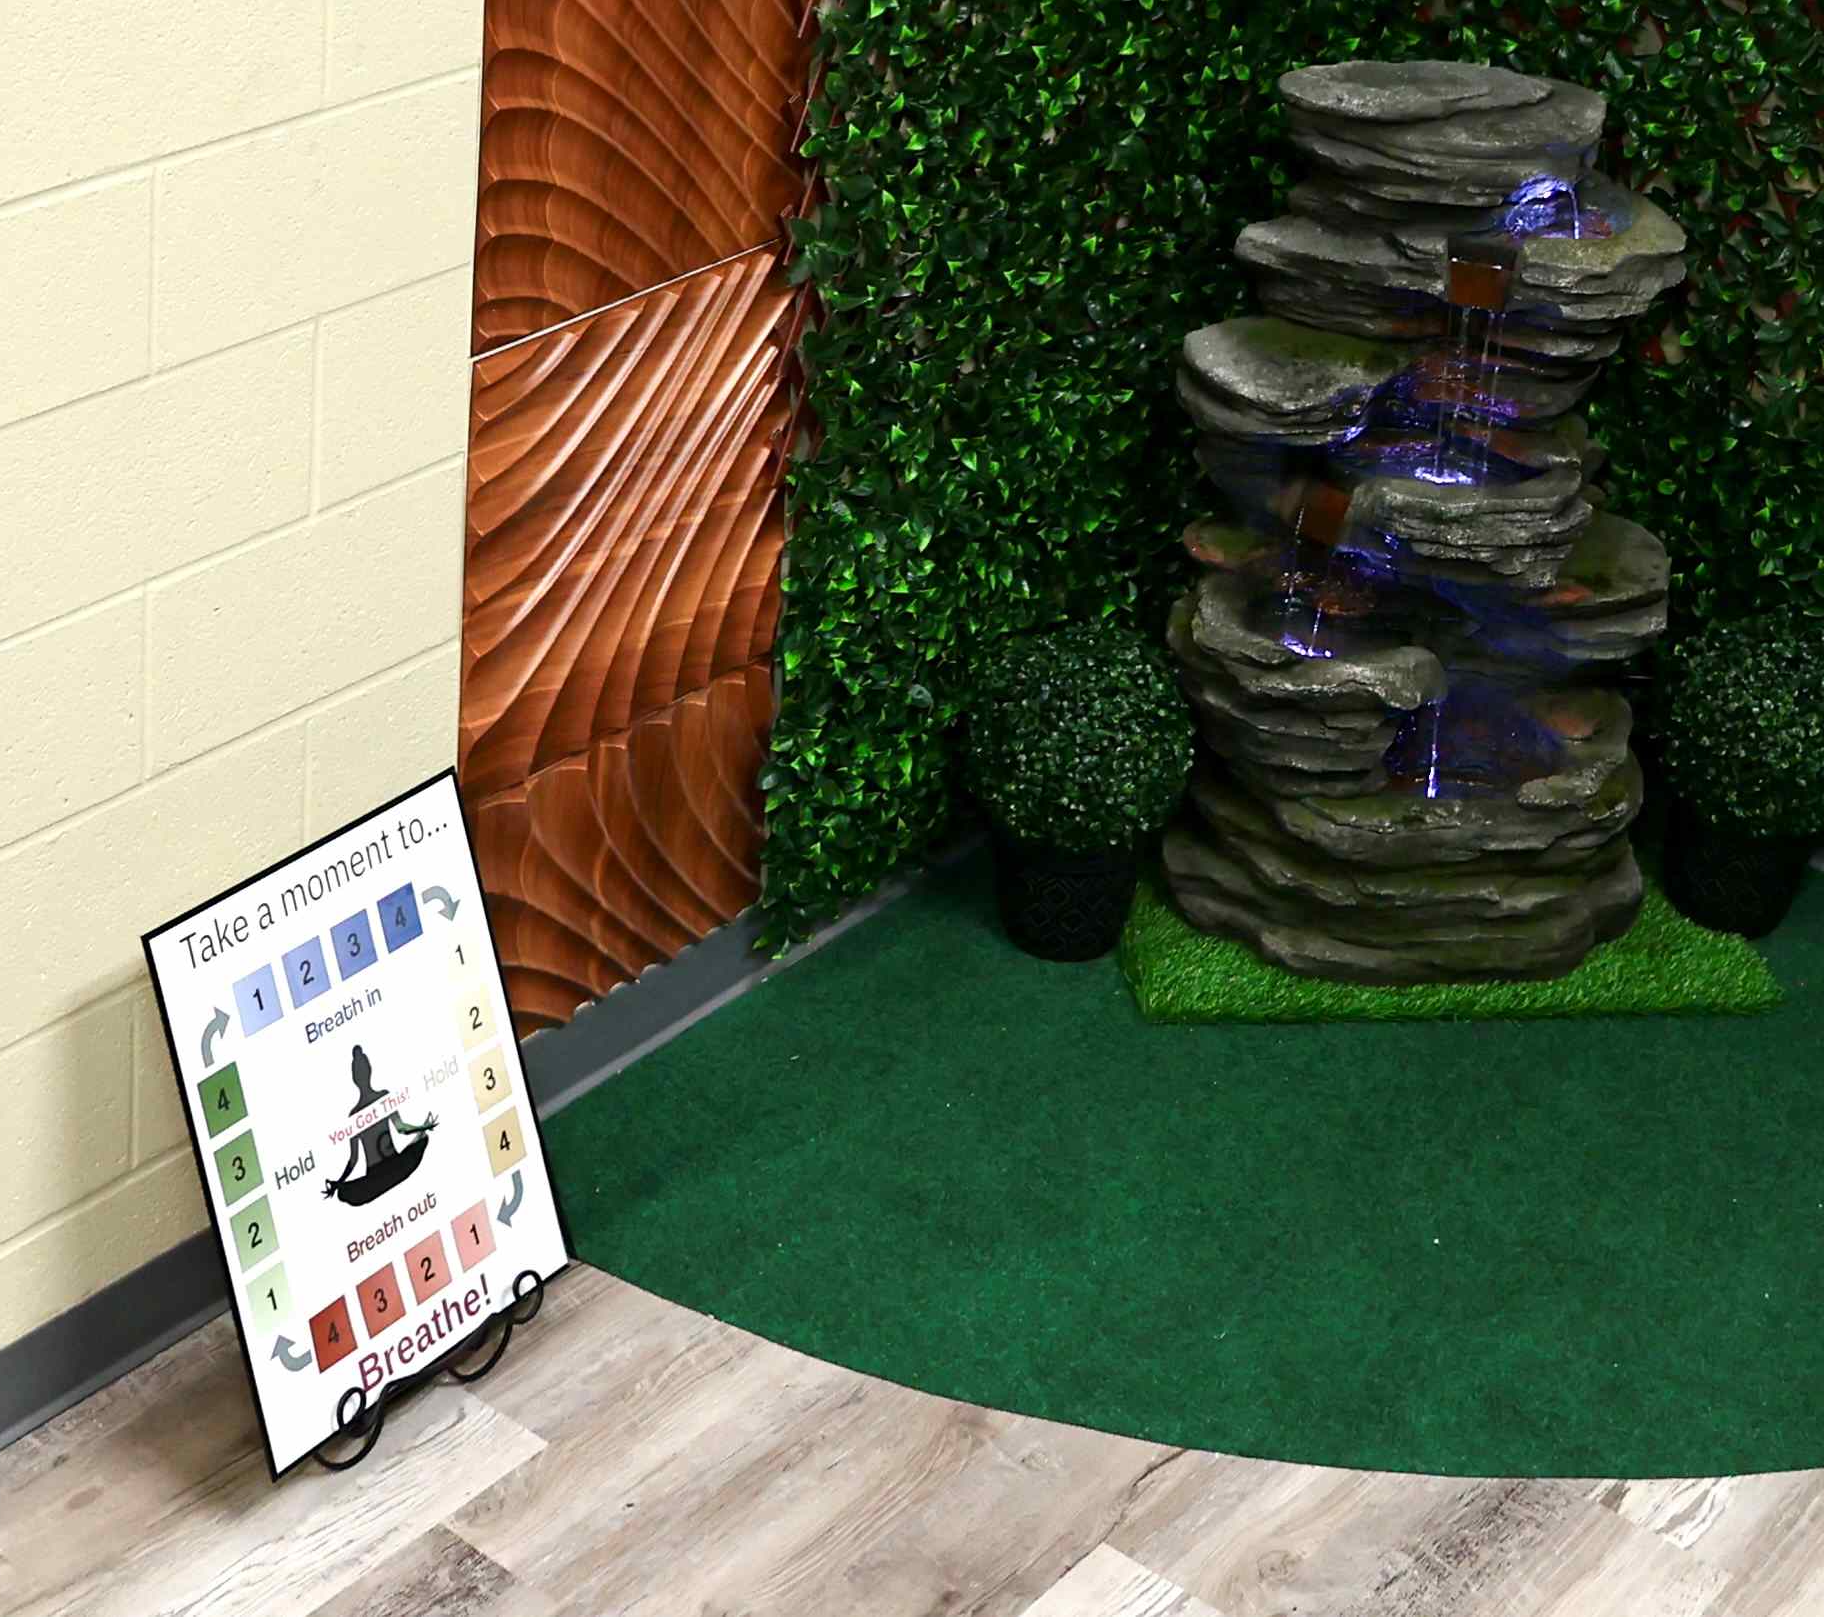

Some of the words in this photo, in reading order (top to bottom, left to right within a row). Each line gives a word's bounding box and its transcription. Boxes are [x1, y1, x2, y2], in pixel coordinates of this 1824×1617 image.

[180, 919, 250, 970] Take
[258, 903, 274, 931] a
[282, 832, 392, 918] moment
[398, 818, 448, 851] to...
[253, 988, 264, 1012] 1
[299, 960, 314, 985] 2
[347, 933, 360, 957] 3
[395, 905, 407, 929] 4
[454, 946, 464, 966] 1
[305, 995, 364, 1044] Breath
[363, 987, 382, 1014] in
[469, 1006, 483, 1031] 2
[423, 1057, 459, 1091] Hold
[484, 1067, 495, 1090] 3
[217, 1089, 230, 1111] 4
[329, 1125, 352, 1145] You
[356, 1107, 379, 1131] Got
[381, 1088, 411, 1115] This!
[499, 1129, 511, 1153] 4
[232, 1156, 245, 1181] 3
[275, 1151, 316, 1190] Hold
[248, 1222, 261, 1248] 2
[347, 1214, 403, 1263] Breath
[408, 1192, 437, 1223] out
[267, 1287, 277, 1311] 1
[328, 1318, 339, 1344] 4
[375, 1288, 389, 1314] 3
[421, 1256, 435, 1281] 2
[471, 1224, 481, 1246] 1
[359, 1273, 492, 1393] Breathe!
